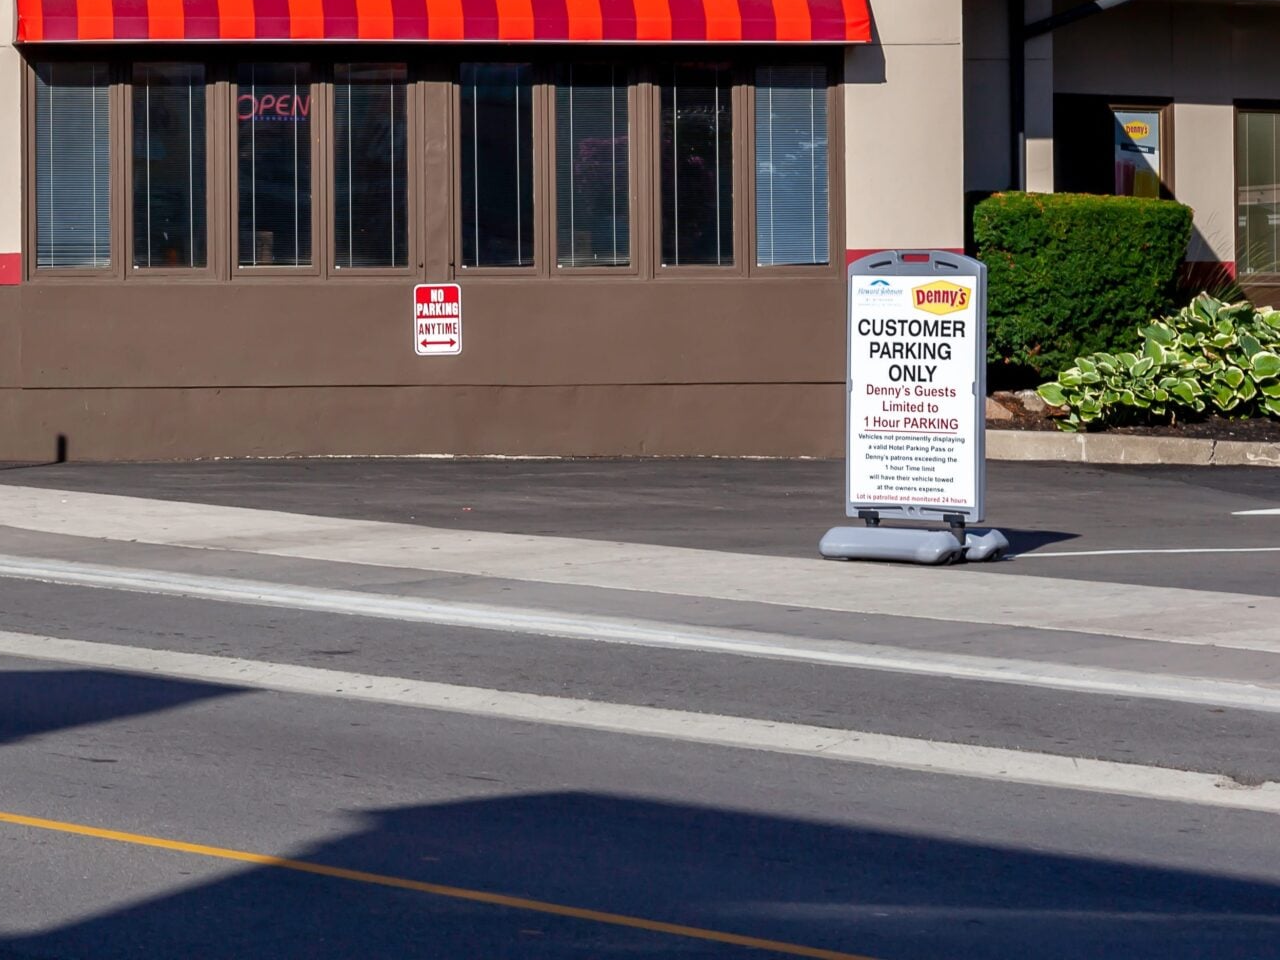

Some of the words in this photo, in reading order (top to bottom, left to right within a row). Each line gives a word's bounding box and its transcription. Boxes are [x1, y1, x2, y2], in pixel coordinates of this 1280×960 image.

[237, 94, 311, 119] OPEN
[430, 288, 444, 302] NO
[916, 288, 967, 307] Denny's
[416, 302, 458, 316] PARKING
[418, 322, 458, 335] ANYTIME
[858, 318, 966, 338] CUSTOMER
[869, 341, 952, 361] PARKING
[888, 364, 938, 383] ONLY
[866, 384, 910, 399] Denny's
[914, 385, 956, 398] Guests
[882, 400, 924, 413] Limited
[928, 402, 939, 414] to
[864, 416, 869, 427] 1
[873, 416, 900, 428] Hour
[904, 417, 959, 430] PARKING
[895, 434, 932, 443] prominently
[932, 436, 966, 444] displaying
[906, 445, 930, 453] Parking
[865, 453, 888, 462] Denny's
[890, 454, 913, 462] patrons
